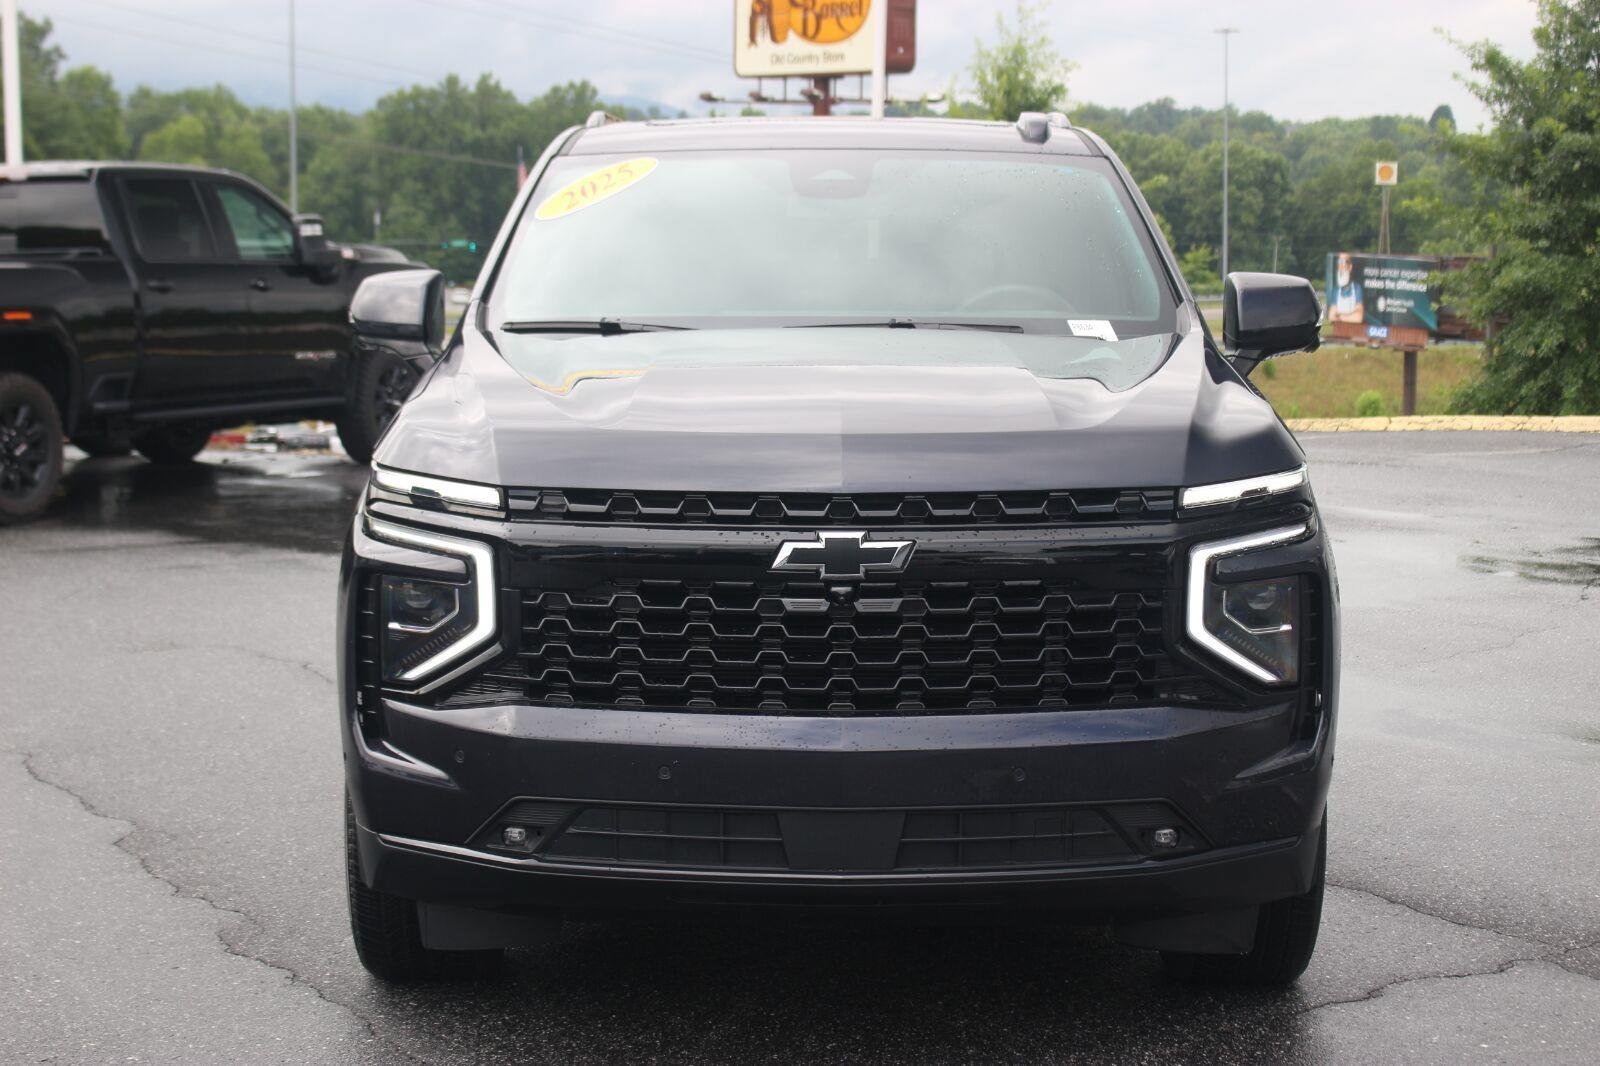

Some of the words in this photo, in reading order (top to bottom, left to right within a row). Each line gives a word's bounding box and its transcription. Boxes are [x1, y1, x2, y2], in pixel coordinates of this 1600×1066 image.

[769, 53, 784, 65] Old
[786, 52, 820, 65] Country
[822, 51, 846, 64] Store
[562, 163, 634, 211] 2025
[1363, 267, 1379, 276] more
[1380, 268, 1400, 277] cancer
[1401, 269, 1428, 279] expertise
[1364, 278, 1384, 288] makes
[1385, 278, 1395, 289] the
[1396, 279, 1428, 292] difference
